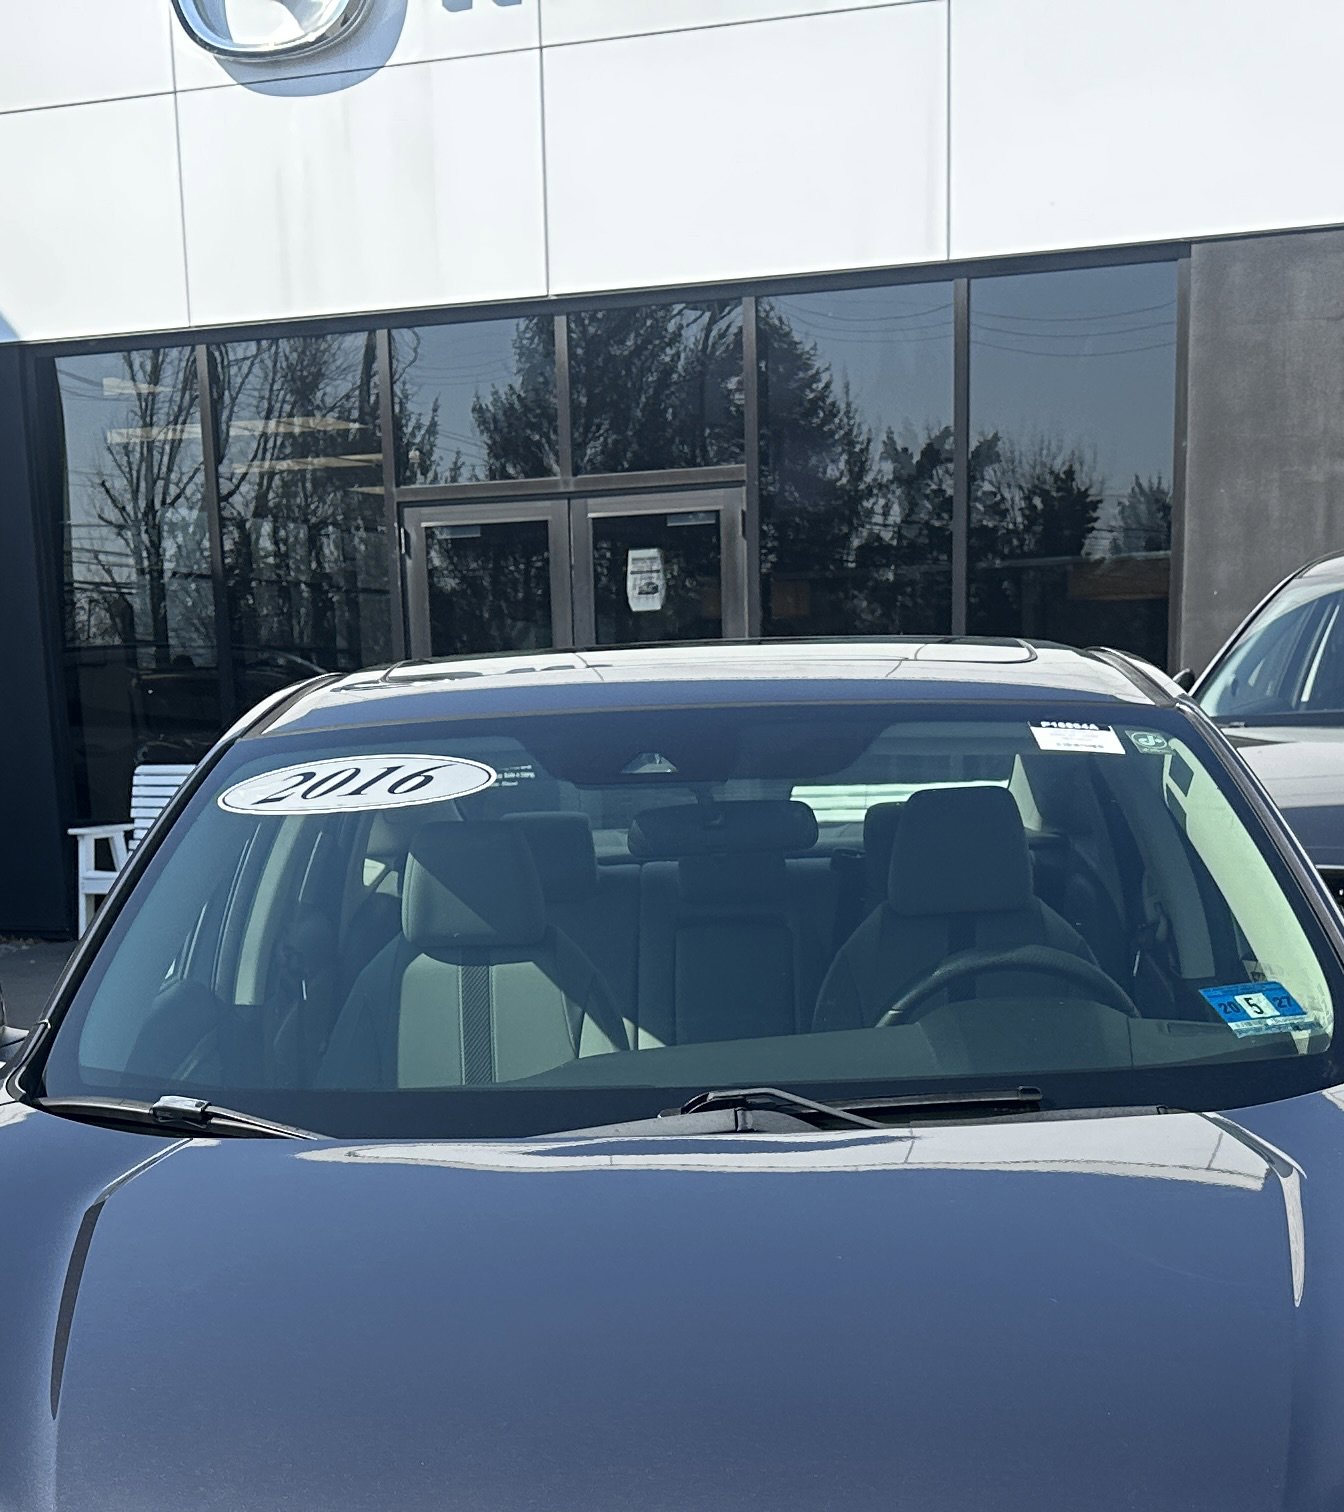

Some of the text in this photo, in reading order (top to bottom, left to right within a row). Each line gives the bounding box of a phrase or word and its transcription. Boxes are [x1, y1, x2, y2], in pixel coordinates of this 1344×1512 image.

[249, 764, 457, 806] 2016
[1217, 996, 1292, 1015] 20 5 27
